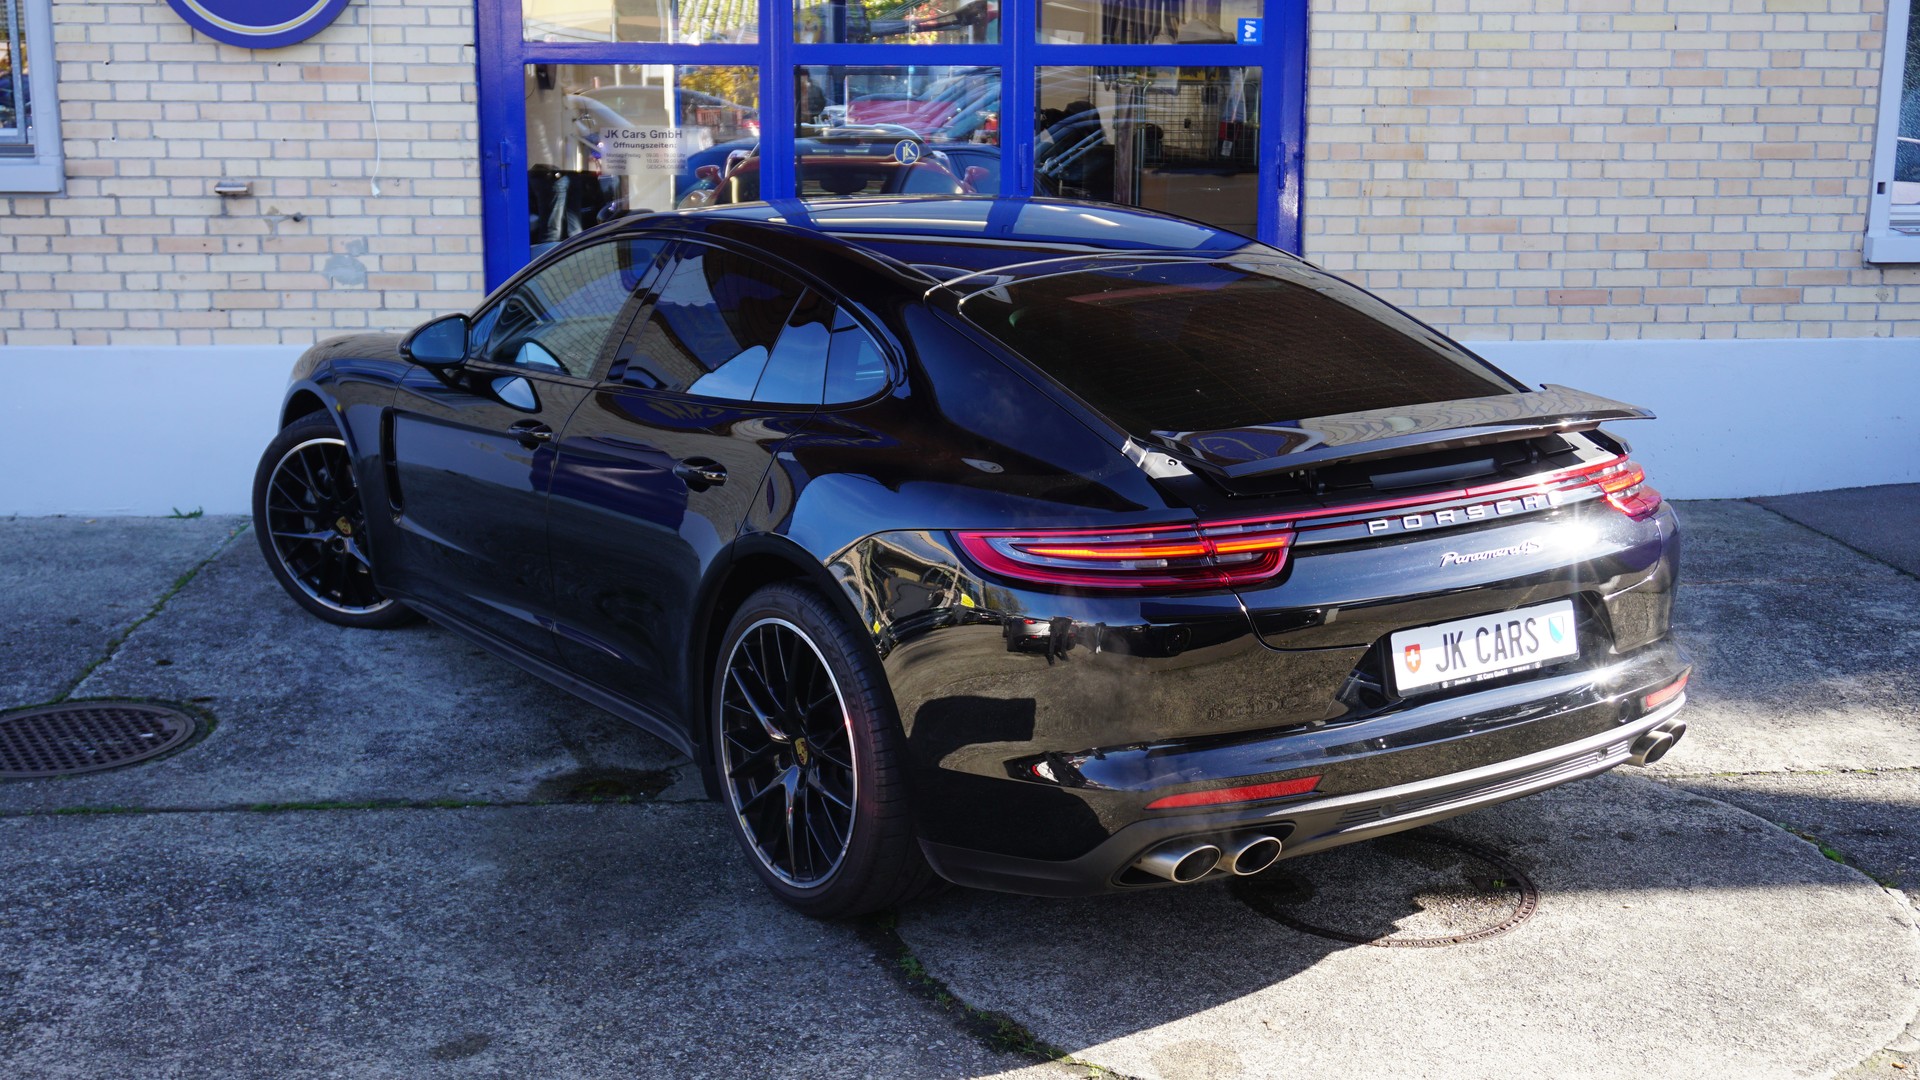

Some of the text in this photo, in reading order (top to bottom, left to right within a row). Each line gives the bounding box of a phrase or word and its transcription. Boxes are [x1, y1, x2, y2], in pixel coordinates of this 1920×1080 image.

[604, 129, 683, 139] JK Cars GmbH
[613, 141, 678, 150] Öffnungszeiten:
[1435, 617, 1540, 673] JK CARS
